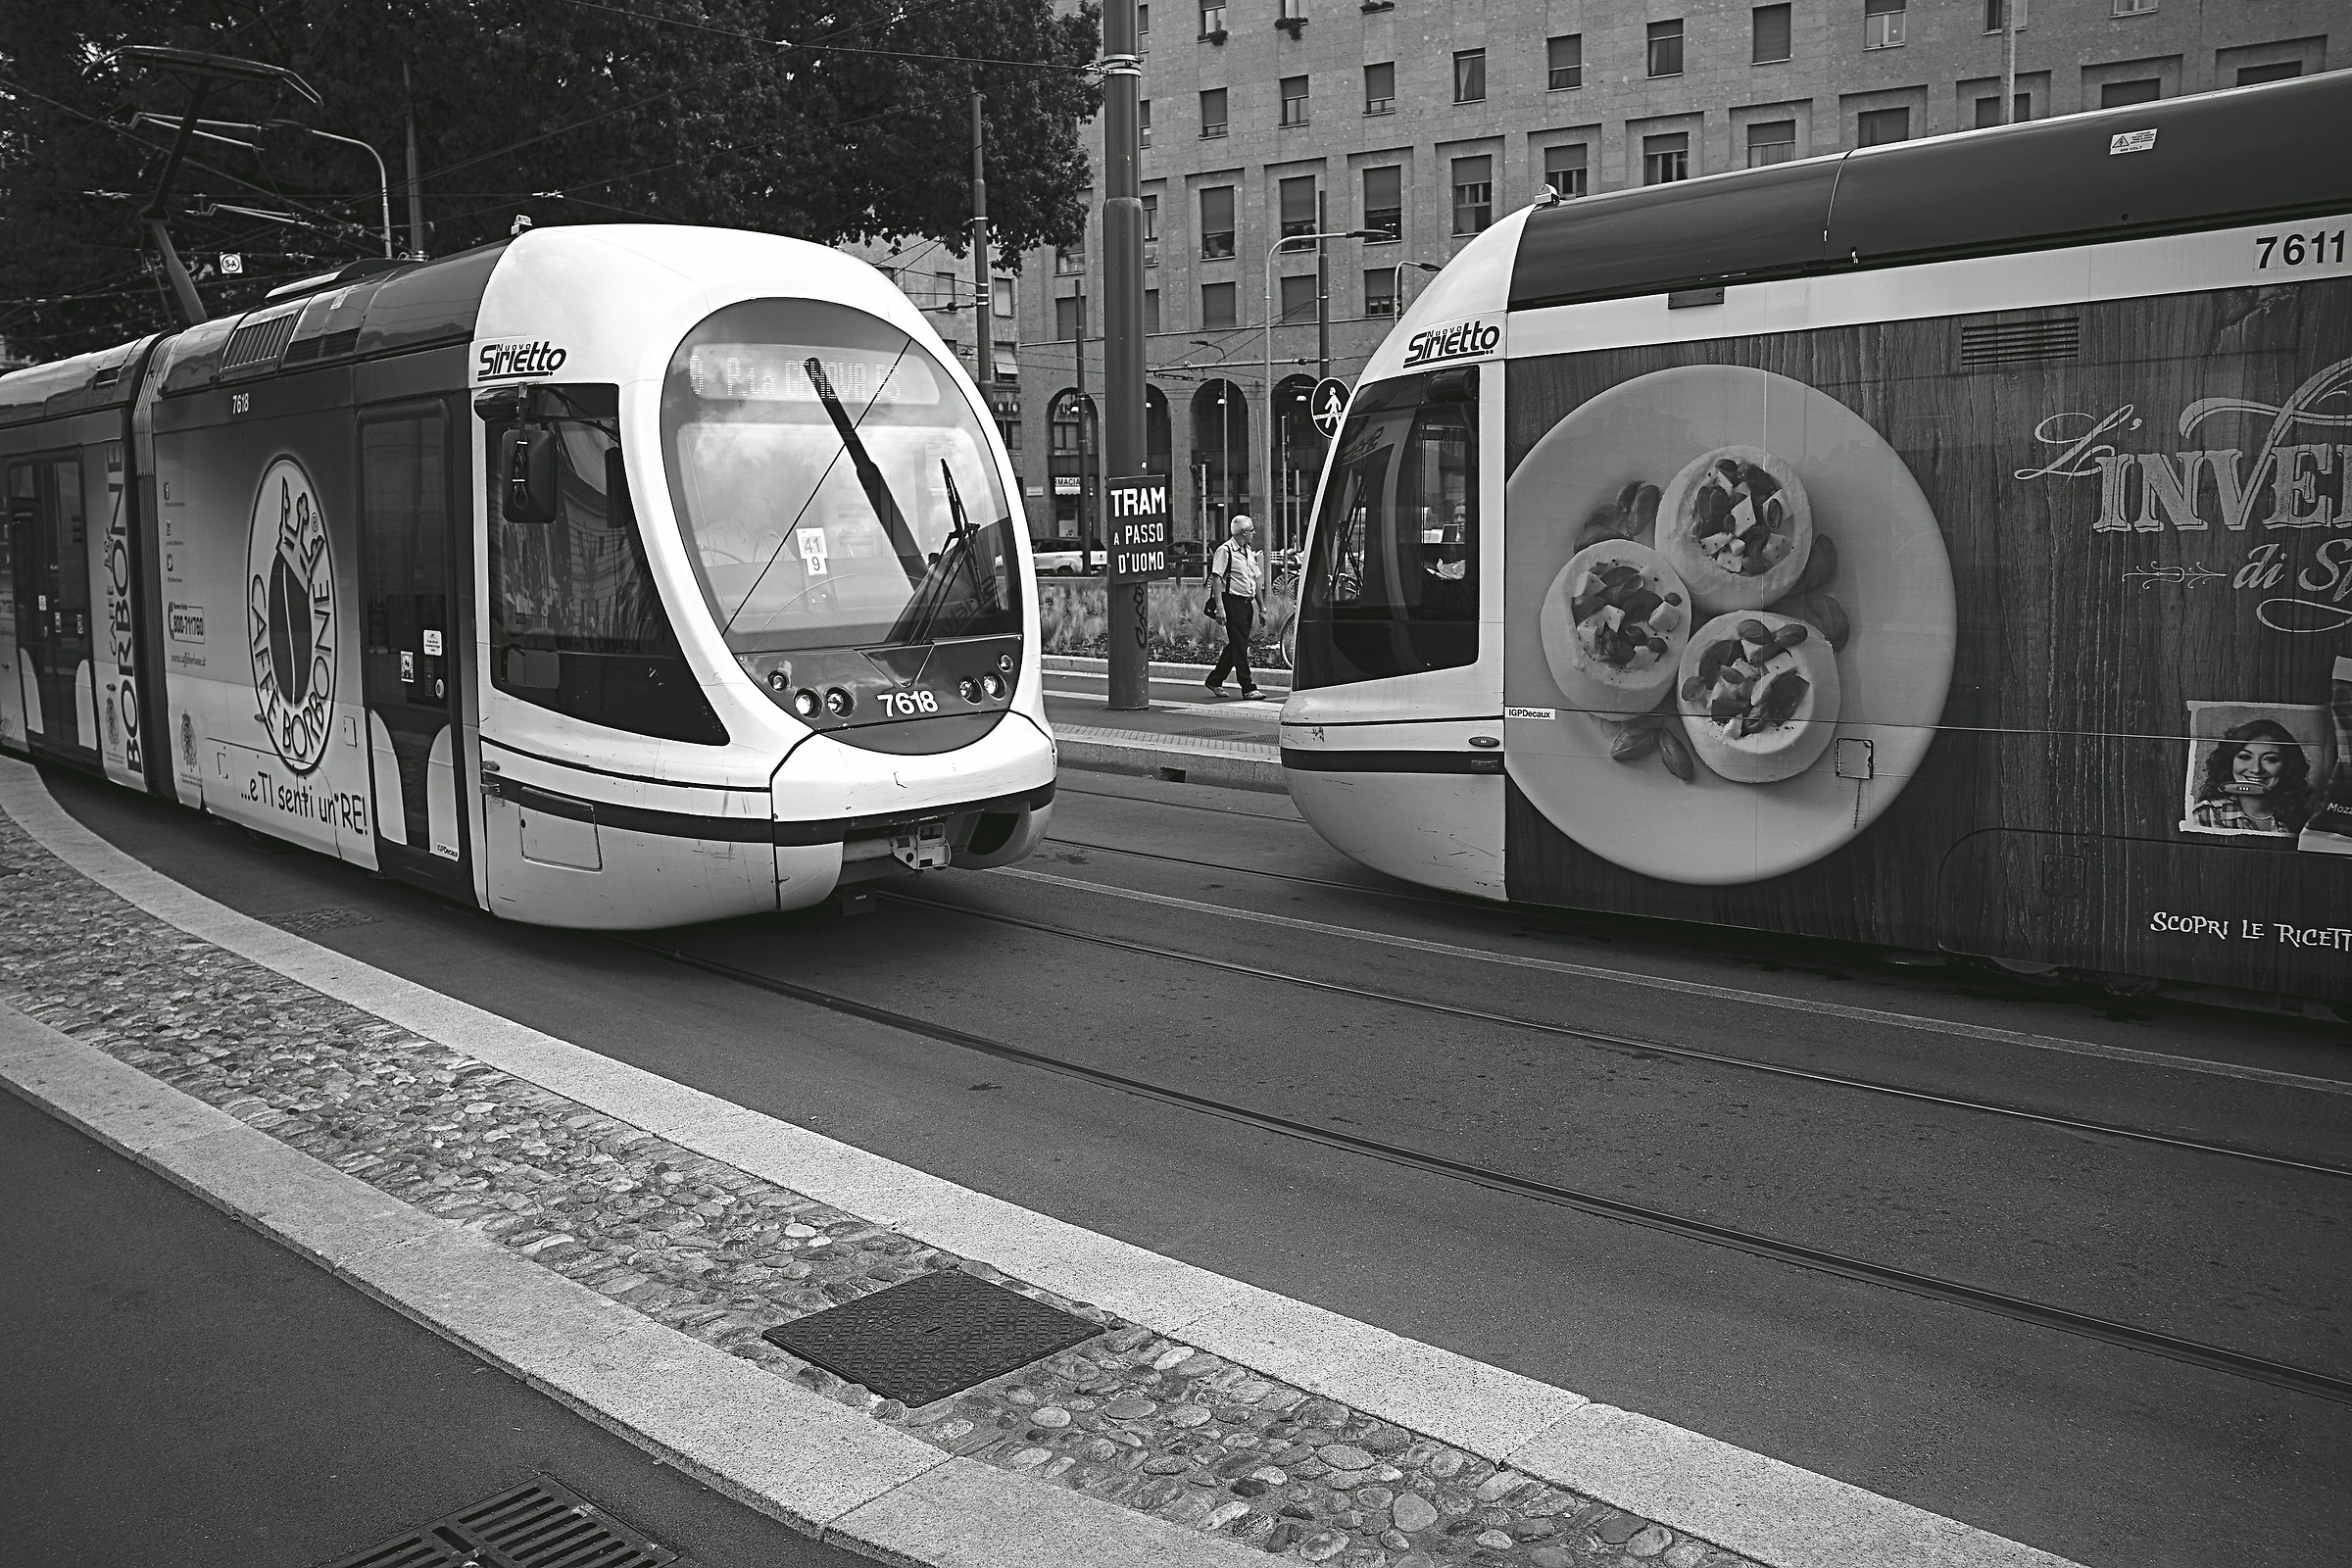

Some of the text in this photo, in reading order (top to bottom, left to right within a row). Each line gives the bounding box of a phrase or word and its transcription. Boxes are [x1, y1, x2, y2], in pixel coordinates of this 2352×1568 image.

[2256, 229, 2345, 270] 7611
[690, 355, 705, 394] 9
[232, 392, 249, 415] 7618
[2015, 392, 2352, 532] L'INVE
[1110, 486, 1166, 517] TRAM
[804, 537, 820, 553] 41
[1113, 522, 1164, 546] A PASSO
[811, 556, 820, 571] 9
[1118, 551, 1165, 574] D'UOMO
[2233, 543, 2287, 589] di
[107, 441, 143, 774] BORBONE
[283, 579, 332, 759] BORBONE
[876, 690, 939, 717] 7618
[1508, 709, 1551, 718] IGPDecaux
[277, 785, 315, 818] senti
[2150, 911, 2230, 941] SCOPRI
[2241, 919, 2265, 940] LE
